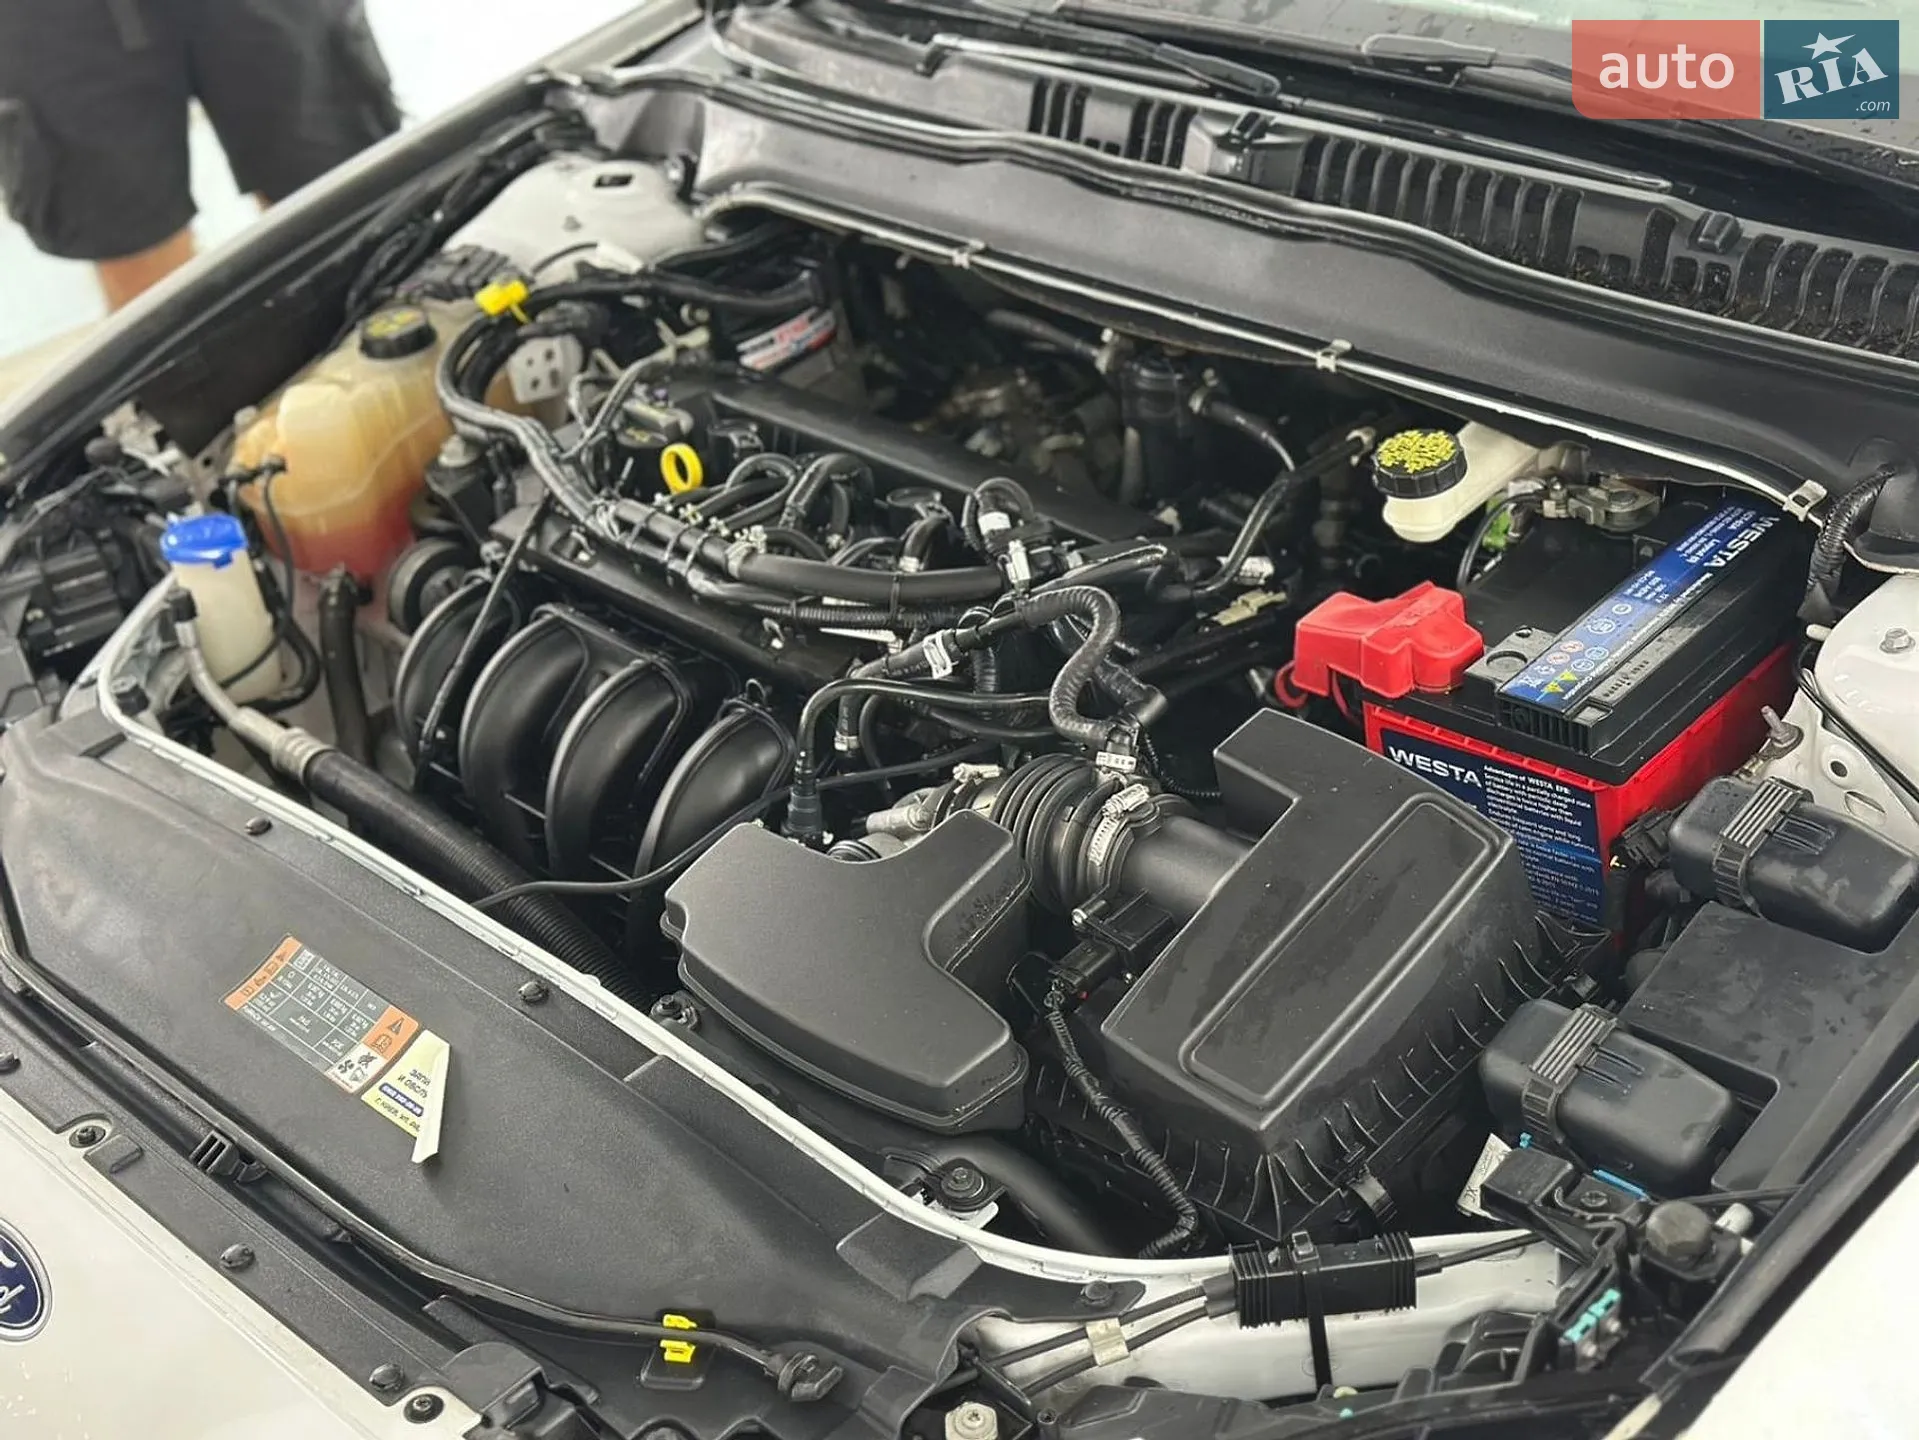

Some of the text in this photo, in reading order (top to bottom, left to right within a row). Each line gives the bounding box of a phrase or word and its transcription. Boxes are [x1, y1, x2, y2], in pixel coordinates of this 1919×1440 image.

[1703, 516, 1780, 567] WESTA
[1389, 746, 1482, 788] WESTA
[1492, 783, 1512, 794] battery
[1513, 789, 1527, 798] with
[1527, 793, 1551, 804] periodic
[1552, 800, 1567, 809] deep
[1527, 778, 1553, 789] WESTA
[1486, 794, 1522, 810] conventional
[1523, 805, 1549, 817] batteries
[1550, 813, 1563, 821] with
[1564, 817, 1581, 826] liquid
[1521, 798, 1537, 807] twice
[1537, 803, 1557, 813] higher
[1527, 786, 1550, 797] partially
[1550, 793, 1575, 804] charged
[1575, 800, 1590, 808] state
